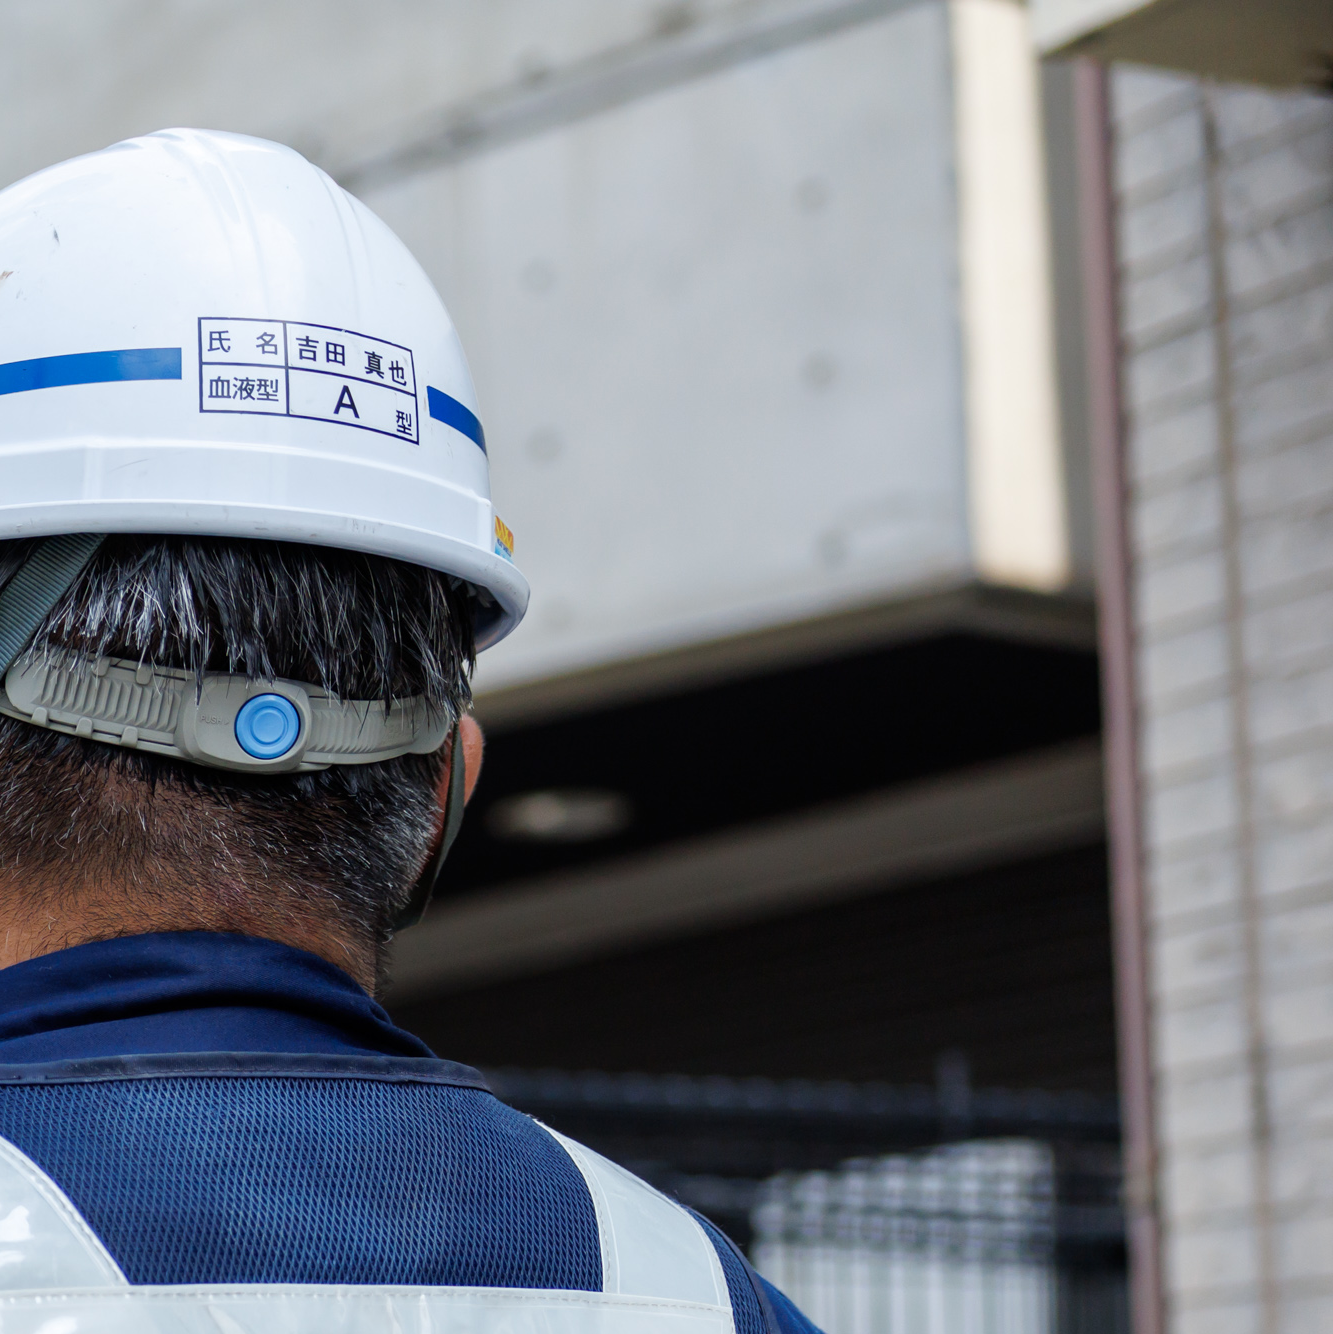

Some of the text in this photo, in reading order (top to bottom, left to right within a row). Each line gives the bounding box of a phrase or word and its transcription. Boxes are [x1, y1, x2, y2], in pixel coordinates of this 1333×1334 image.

[295, 336, 346, 366] 吉田
[364, 351, 407, 386] 真也
[208, 376, 413, 437] 血液型 A 型
[200, 714, 222, 725] PUSH
